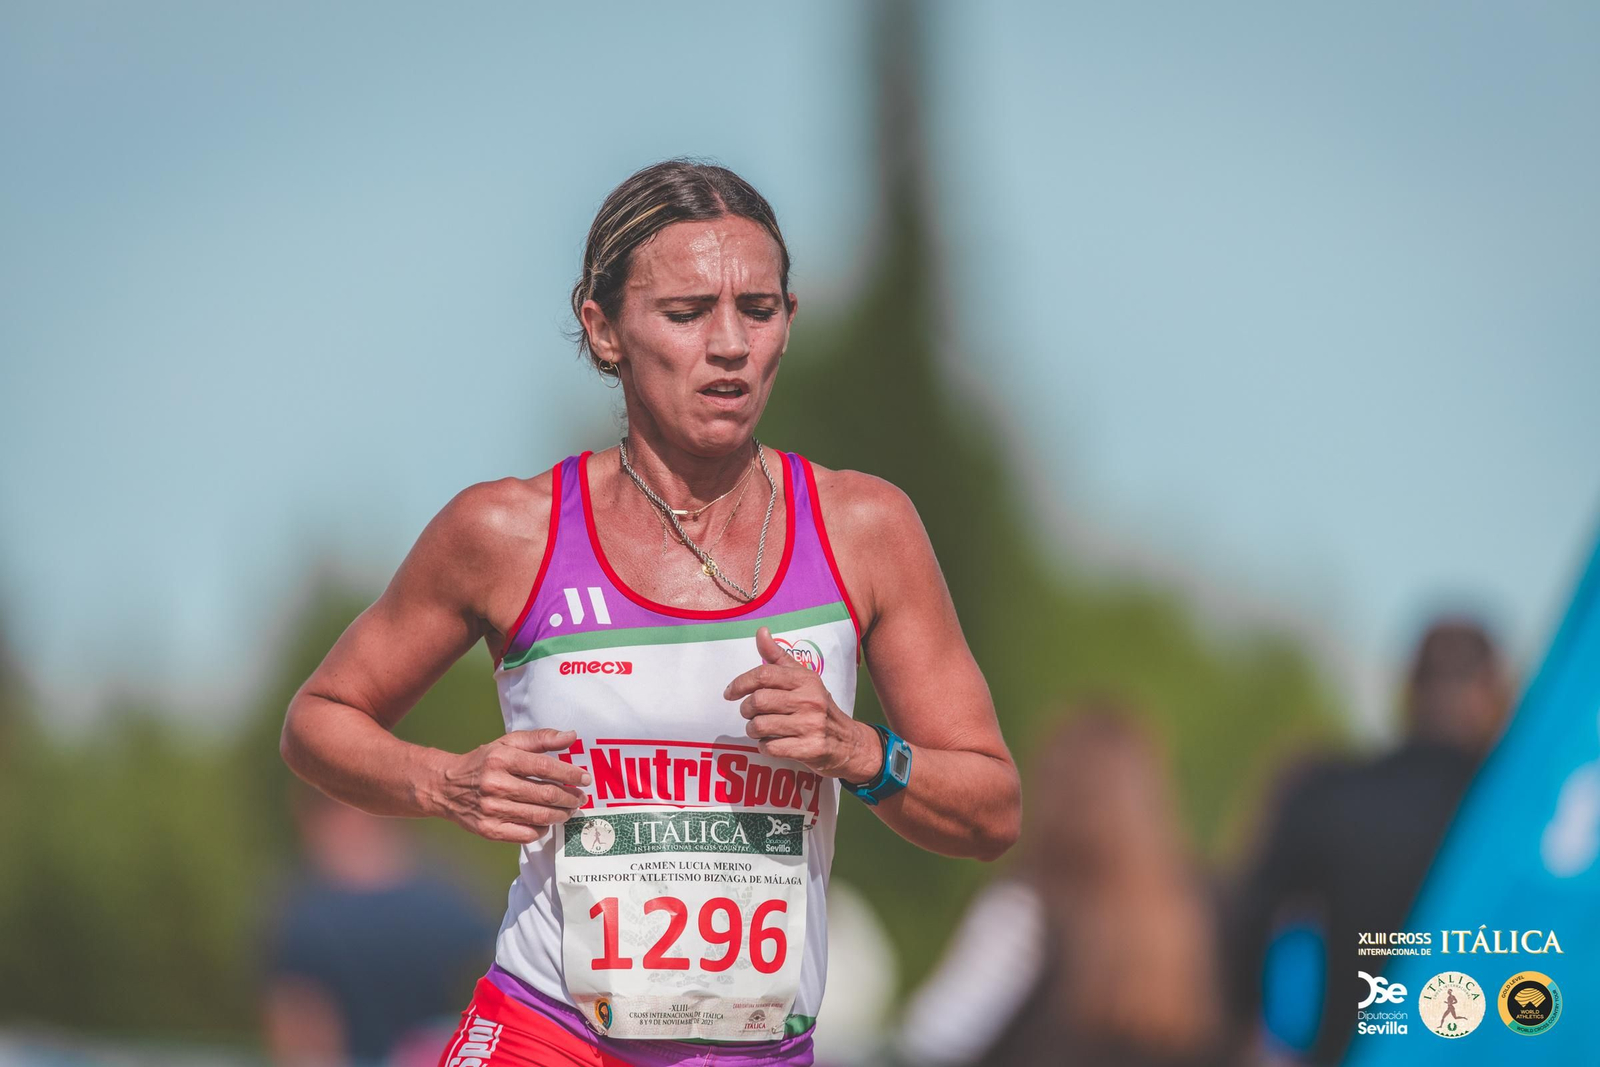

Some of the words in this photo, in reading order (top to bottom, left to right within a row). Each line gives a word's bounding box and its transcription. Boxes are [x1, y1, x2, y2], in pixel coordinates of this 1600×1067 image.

[559, 660, 615, 675] emec
[590, 749, 823, 812] NutriSport
[634, 815, 749, 845] ITÁLICA
[634, 844, 692, 852] INTERNATIONAL
[766, 844, 790, 853] Sevilla
[630, 861, 676, 871] CARMEN
[679, 861, 711, 870] LUCIA
[713, 861, 752, 872] MERINO
[569, 873, 637, 884] NUTRISPORT
[639, 872, 701, 882] ATLETISMO
[703, 874, 747, 884] BIZNAGA
[749, 875, 762, 884] DE
[763, 874, 802, 886] MÁLAGA
[589, 896, 788, 974] 1296
[629, 1011, 649, 1019] CROSS
[649, 1011, 693, 1019] INTERNACIONAL
[662, 1018, 693, 1026] NOVIEMBRE
